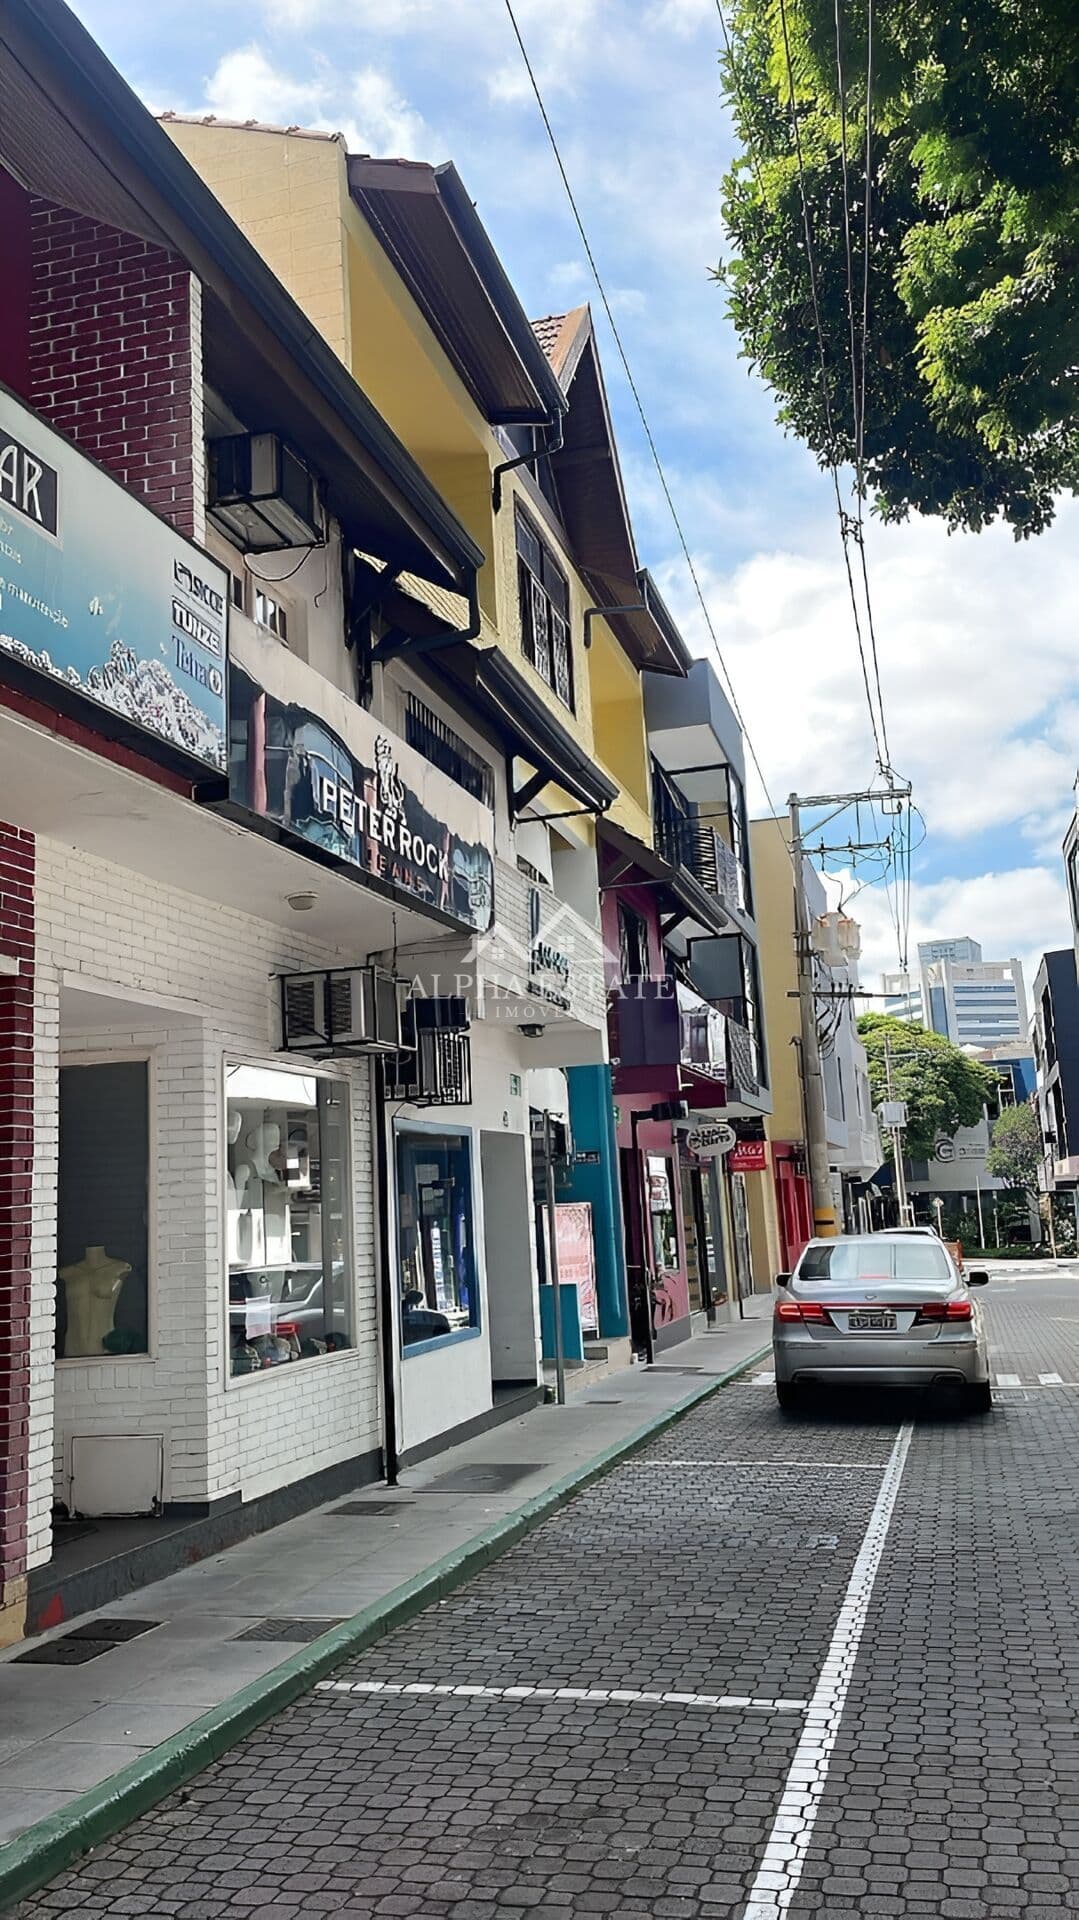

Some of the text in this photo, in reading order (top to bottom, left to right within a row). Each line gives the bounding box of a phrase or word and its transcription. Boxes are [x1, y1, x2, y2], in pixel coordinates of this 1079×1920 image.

[173, 602, 221, 656] TUNZE
[323, 777, 449, 881] PETER ROCK
